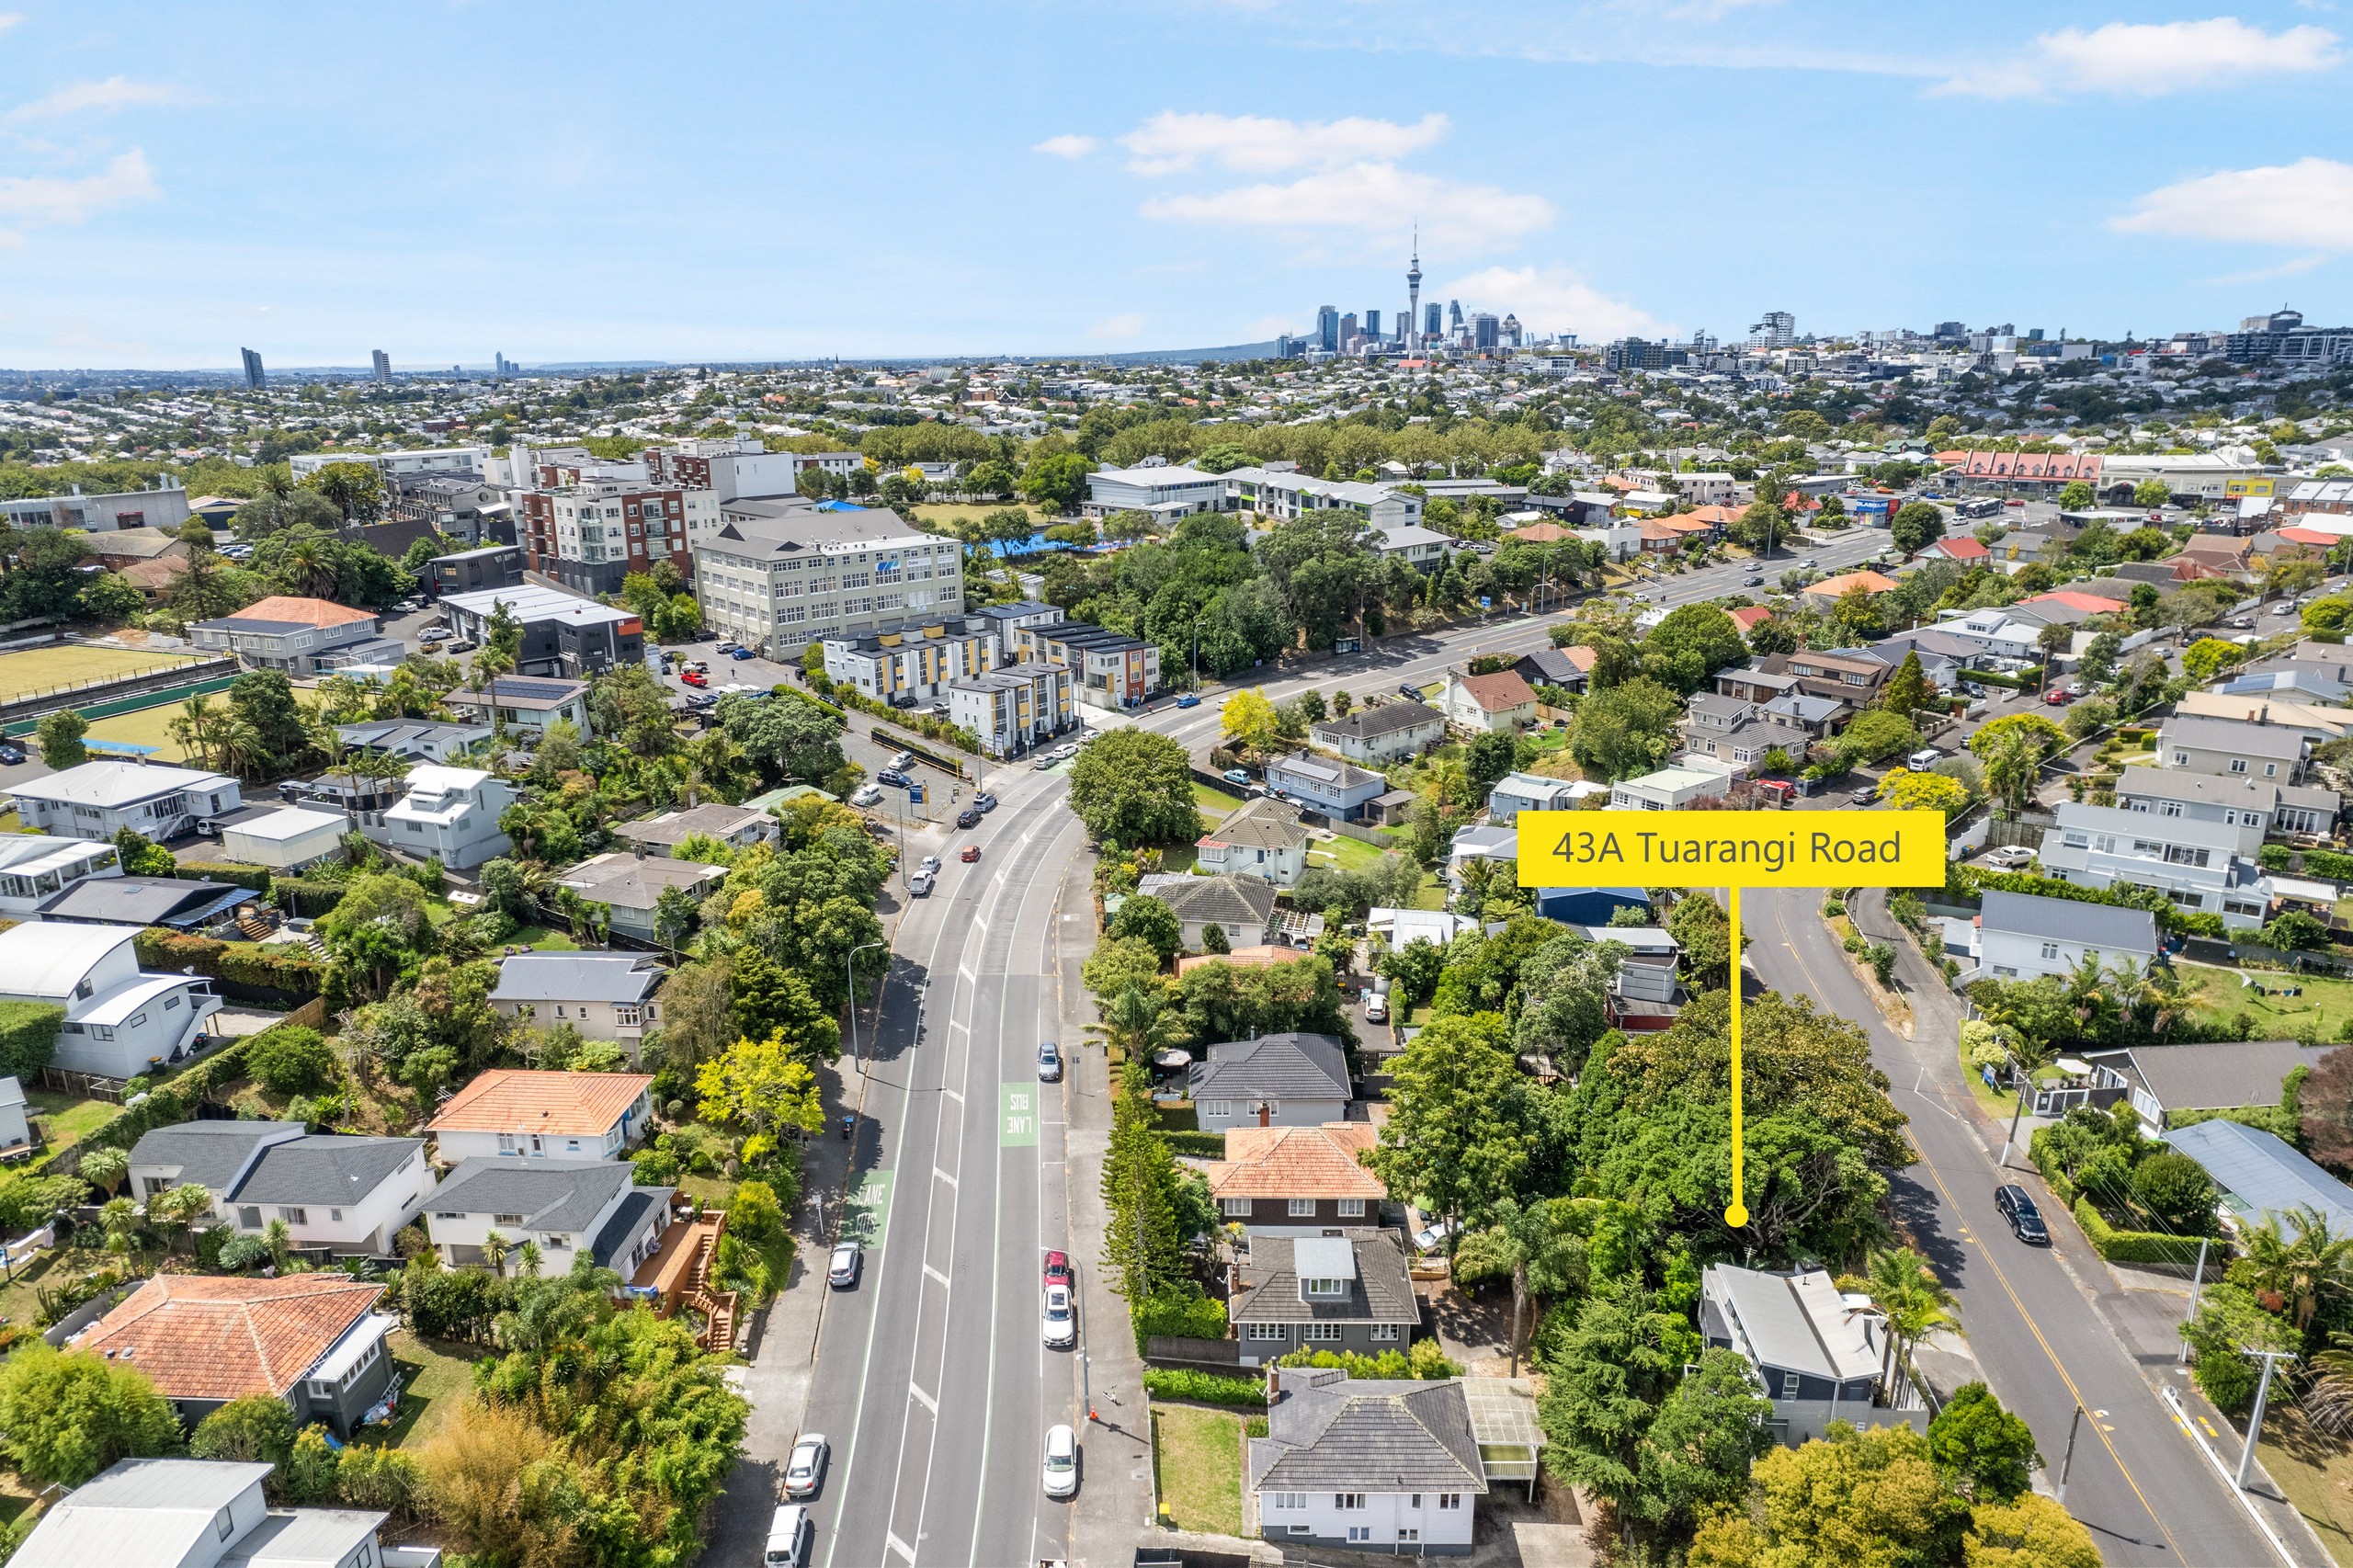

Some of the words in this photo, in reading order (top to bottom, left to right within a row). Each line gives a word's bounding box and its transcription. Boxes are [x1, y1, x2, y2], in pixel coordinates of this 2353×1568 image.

[1010, 1094, 1029, 1110] BUS
[1006, 1116, 1031, 1133] LANE
[857, 1184, 885, 1206] LANE
[856, 1212, 878, 1234] BUS
